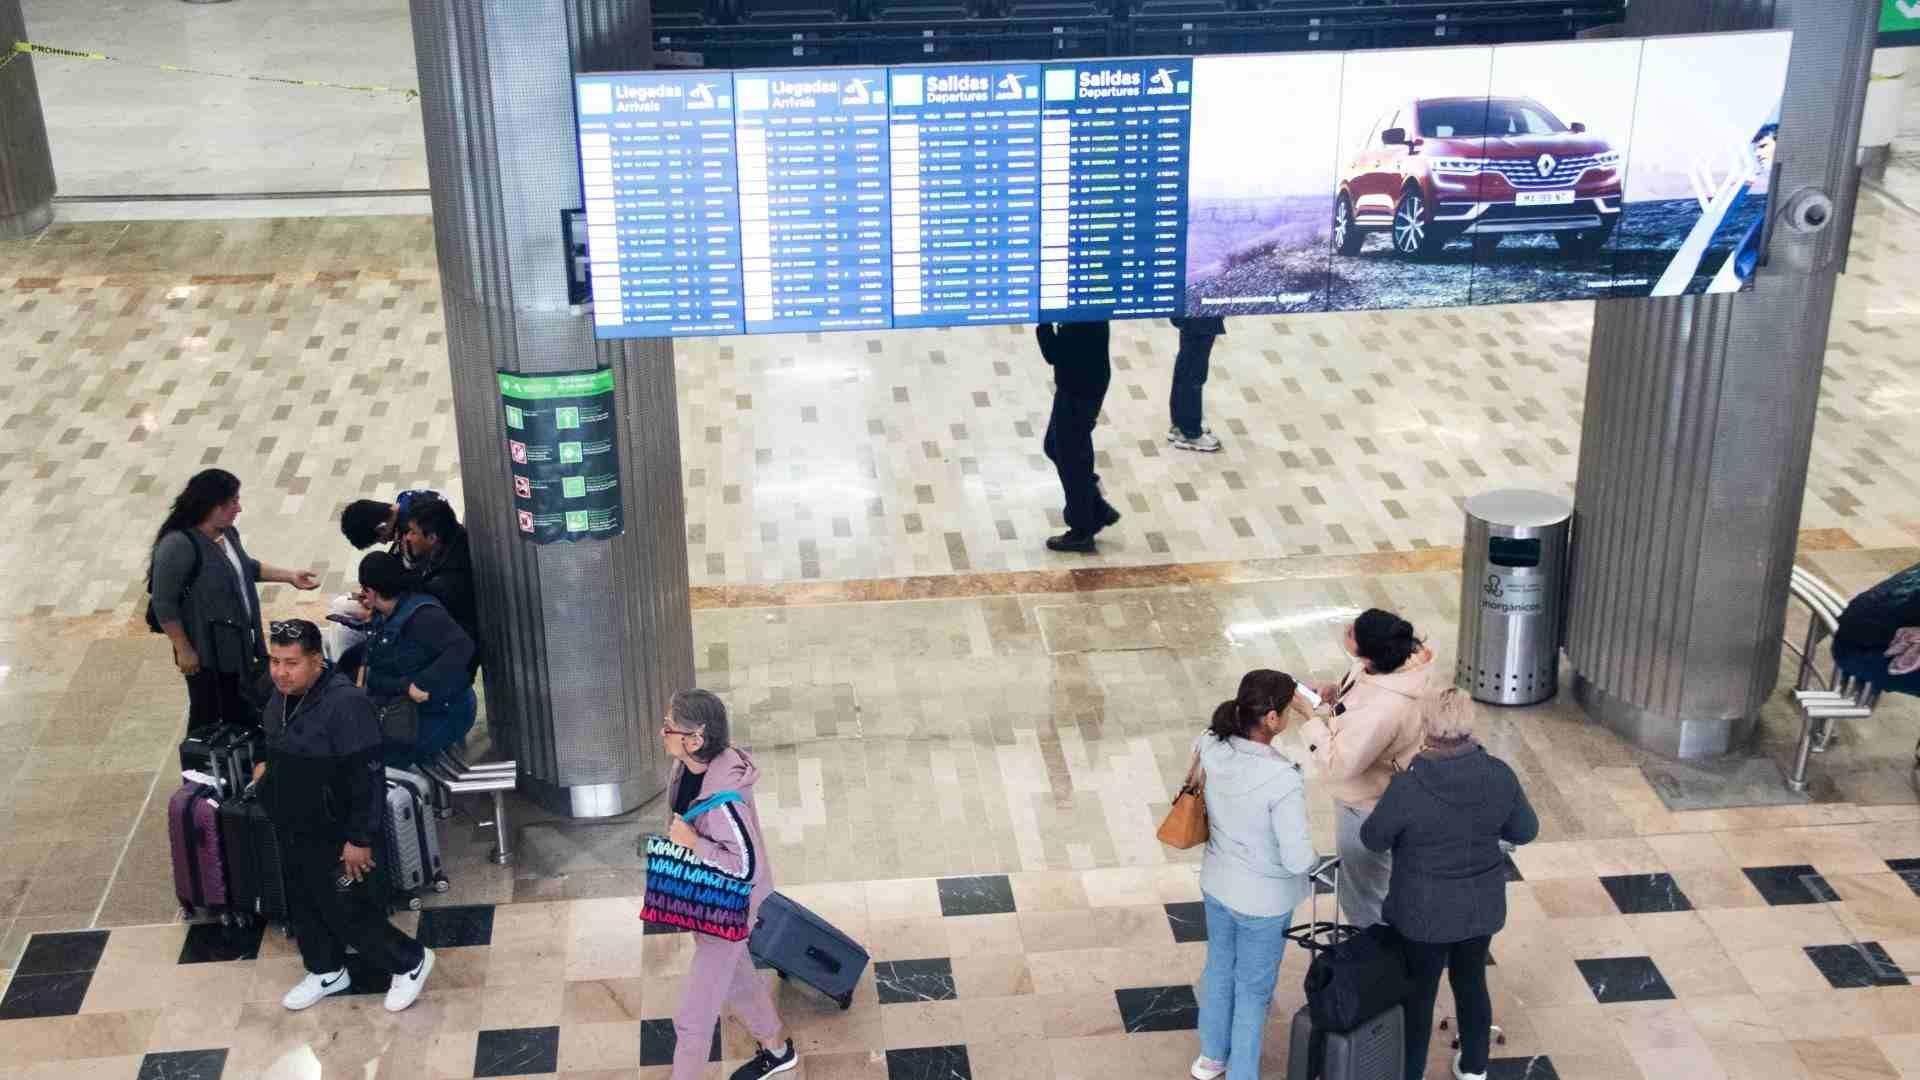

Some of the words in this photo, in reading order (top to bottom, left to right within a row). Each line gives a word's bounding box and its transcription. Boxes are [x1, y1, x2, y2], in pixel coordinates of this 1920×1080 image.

[927, 75, 989, 92] Salidas
[1079, 69, 1140, 86] Salidas
[616, 84, 682, 101] Llegadas
[772, 80, 836, 97] Llegadas
[1079, 86, 1139, 98] Departures
[772, 97, 816, 109] Arrivals
[927, 92, 988, 104] Departures
[616, 101, 660, 113] Arrivals
[651, 858, 682, 878] MIAMI
[684, 867, 725, 888] MIAMI
